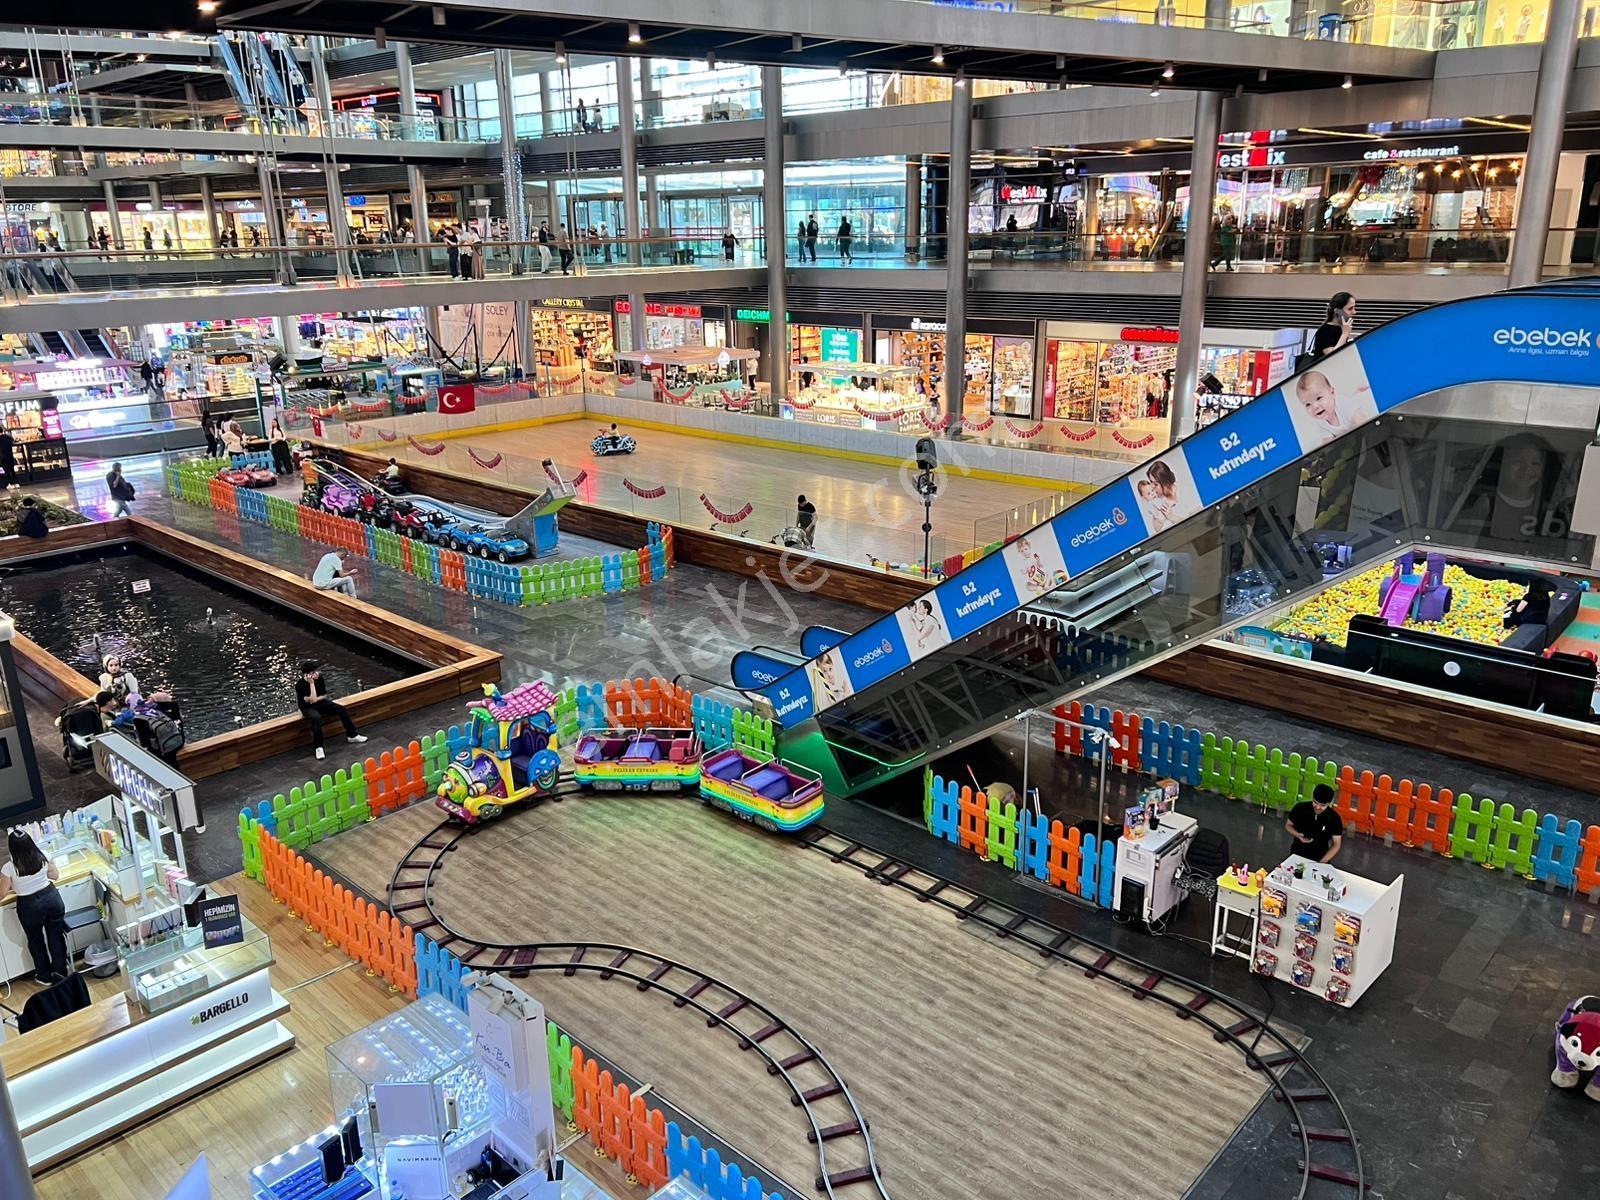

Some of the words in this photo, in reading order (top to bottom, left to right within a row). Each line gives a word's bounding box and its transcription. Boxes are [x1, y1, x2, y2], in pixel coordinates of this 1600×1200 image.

[486, 305, 508, 316] SOLEY
[1493, 326, 1592, 348] ebebek
[816, 414, 836, 424] LORIS
[1219, 431, 1241, 452] B2
[1208, 437, 1277, 480] katındayız
[1071, 518, 1115, 548] ebebek
[962, 581, 977, 596] B2
[956, 588, 1002, 618] katındayız
[854, 646, 884, 668] ebebek
[779, 687, 791, 700] B2
[200, 992, 249, 1023] BARGELLO
